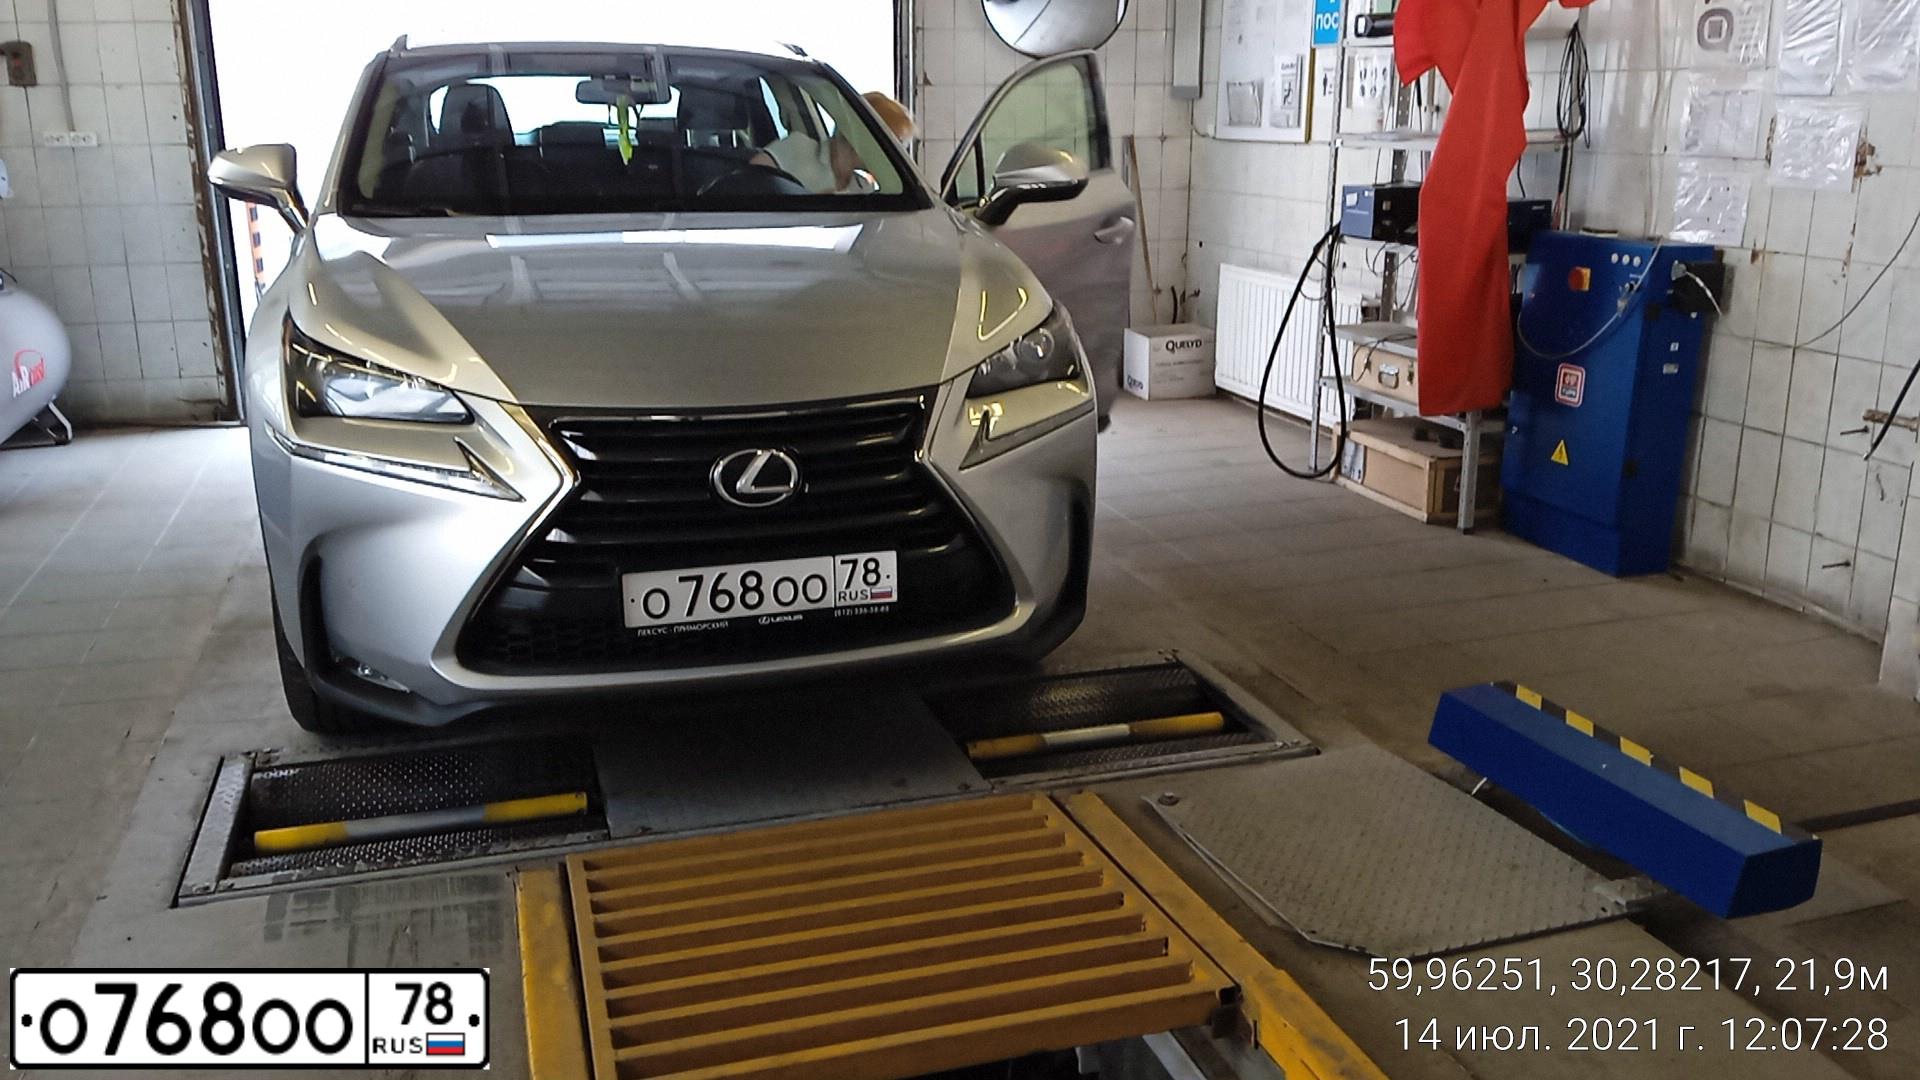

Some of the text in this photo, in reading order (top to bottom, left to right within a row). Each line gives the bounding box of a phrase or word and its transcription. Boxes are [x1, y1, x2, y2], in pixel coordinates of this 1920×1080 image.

[840, 557, 882, 590] 78
[838, 588, 869, 602] RUS
[771, 614, 803, 623] LEXUS
